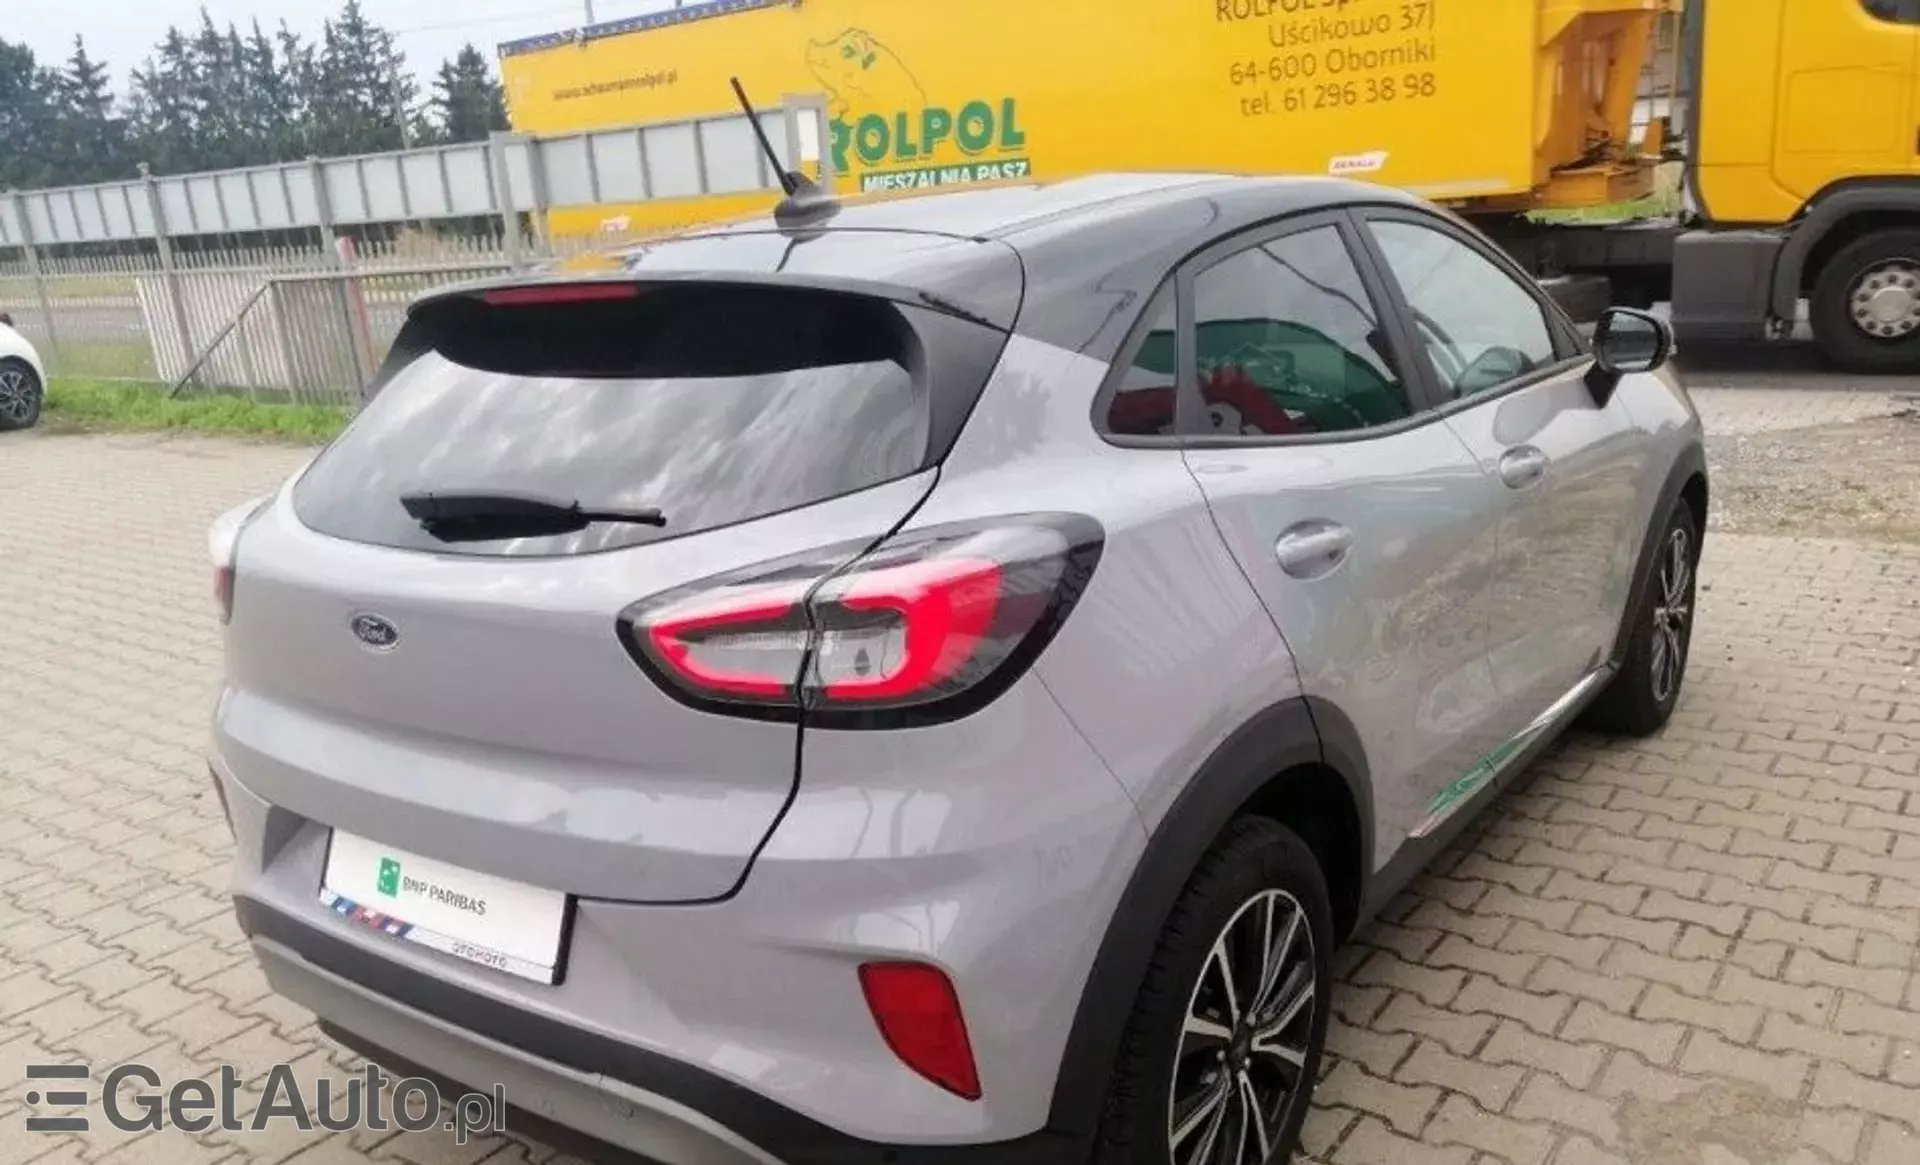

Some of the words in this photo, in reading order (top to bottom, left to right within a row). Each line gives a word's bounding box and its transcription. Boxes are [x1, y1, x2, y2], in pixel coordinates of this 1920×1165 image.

[1267, 14, 1391, 48] Uścikowo
[1229, 53, 1317, 86] 64-600
[1325, 37, 1436, 74] Oborniki
[1283, 87, 1305, 112] 61
[1313, 81, 1357, 110] 296
[1365, 77, 1396, 104] 38
[1402, 71, 1436, 99] 98
[976, 161, 1028, 182] PASZ
[403, 875, 428, 894] BNP
[429, 884, 486, 916] PARIBAS
